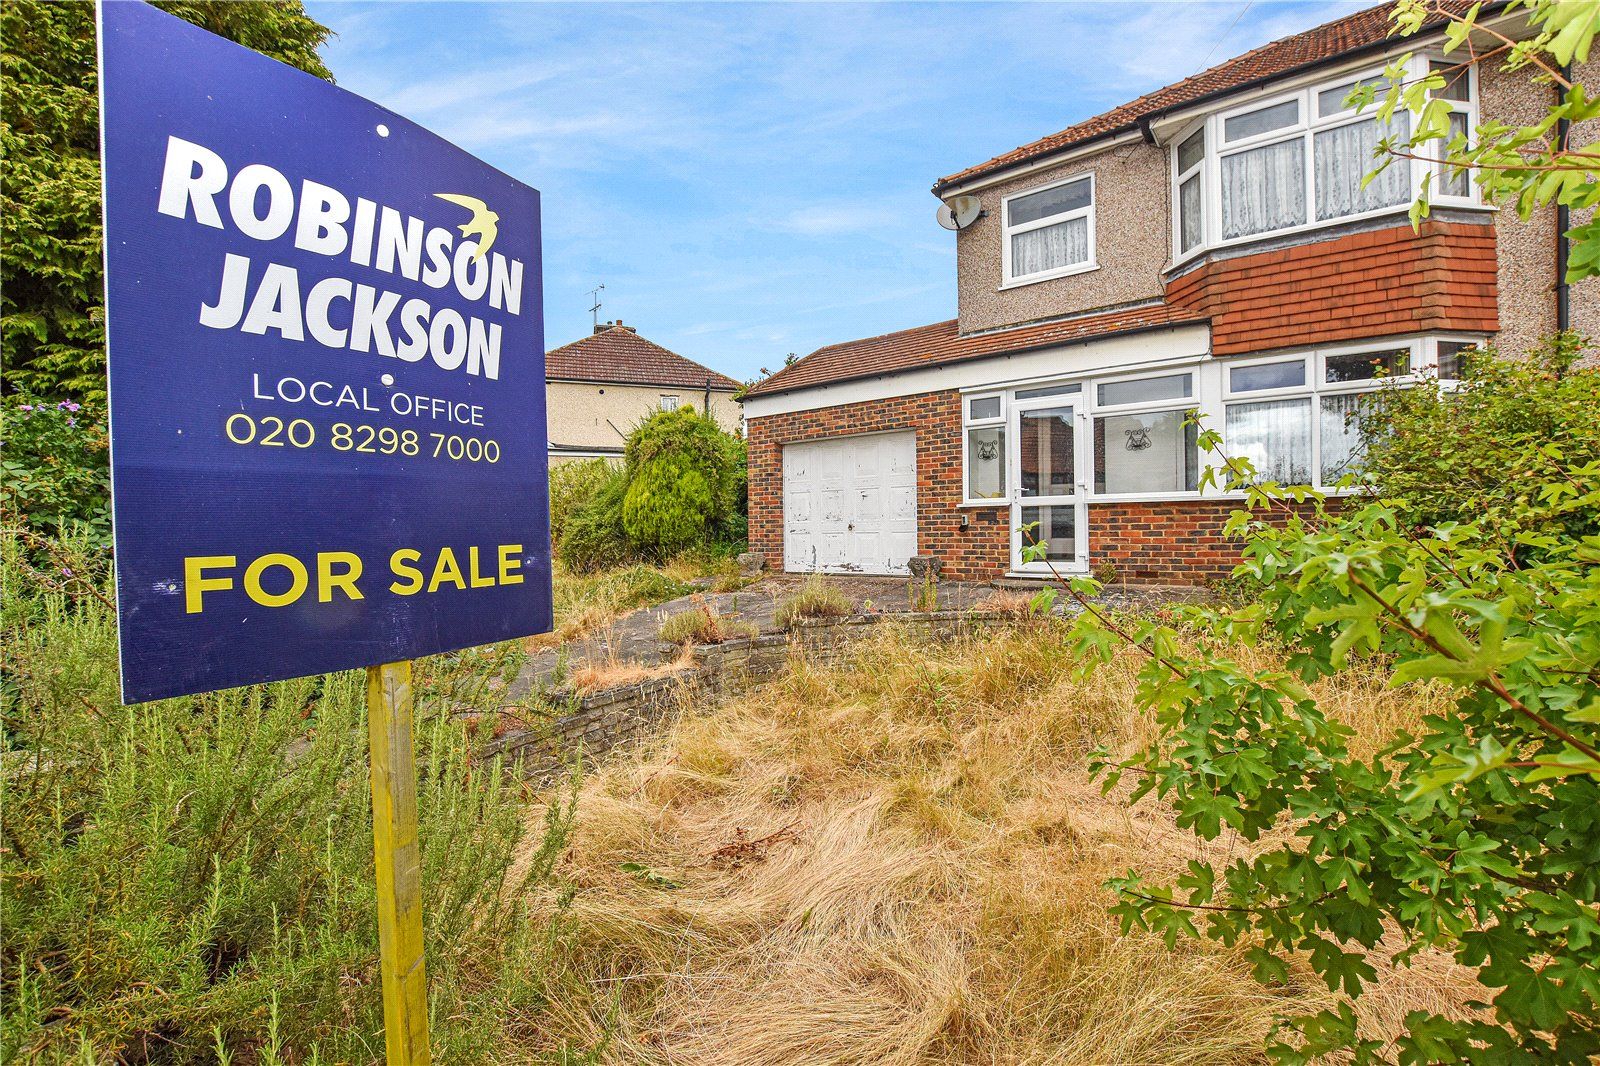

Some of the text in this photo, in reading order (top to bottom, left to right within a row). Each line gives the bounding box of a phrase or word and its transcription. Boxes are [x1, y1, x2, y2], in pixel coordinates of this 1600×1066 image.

[158, 135, 524, 316] ROBINSON
[199, 253, 503, 380] JACKSON
[252, 373, 485, 427] LOCAL OFFICE
[225, 413, 501, 464] 020 8298 7000
[184, 544, 524, 614] FOR SALE
